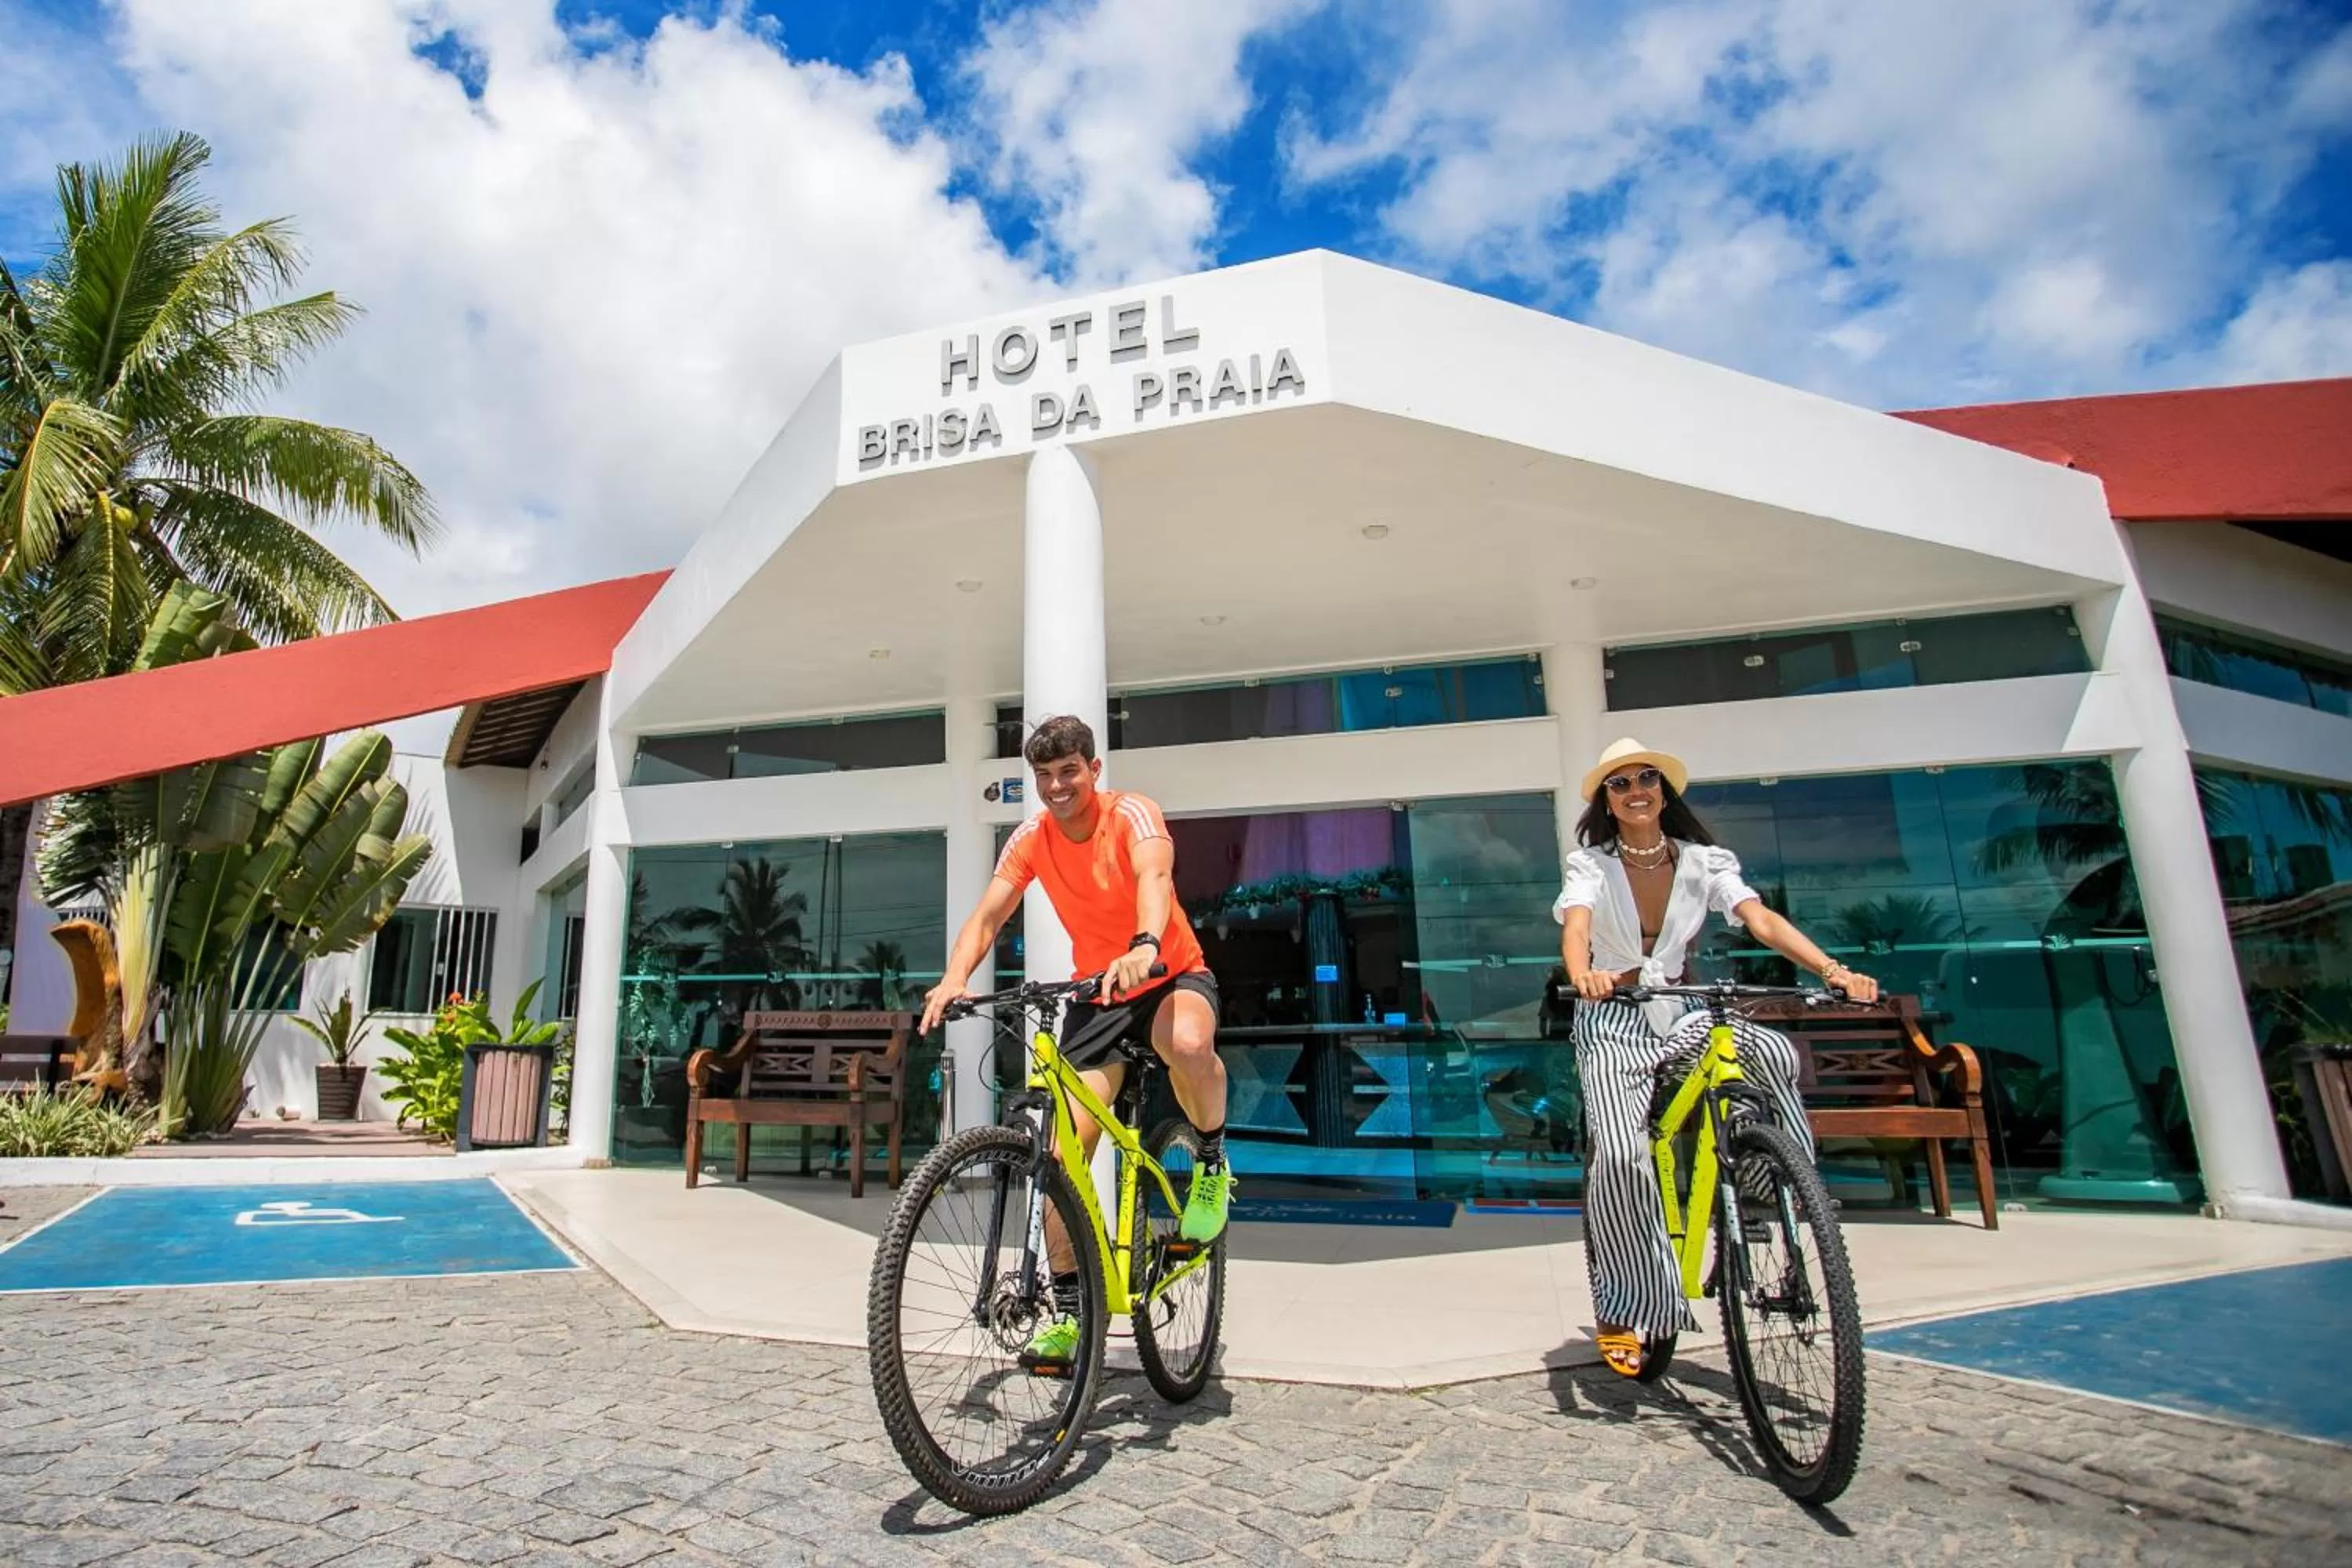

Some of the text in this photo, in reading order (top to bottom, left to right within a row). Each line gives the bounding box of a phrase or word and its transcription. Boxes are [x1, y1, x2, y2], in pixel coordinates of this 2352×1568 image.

[941, 296, 1200, 387] HOTEL
[858, 349, 1305, 463] BRISA DA PRAIA
